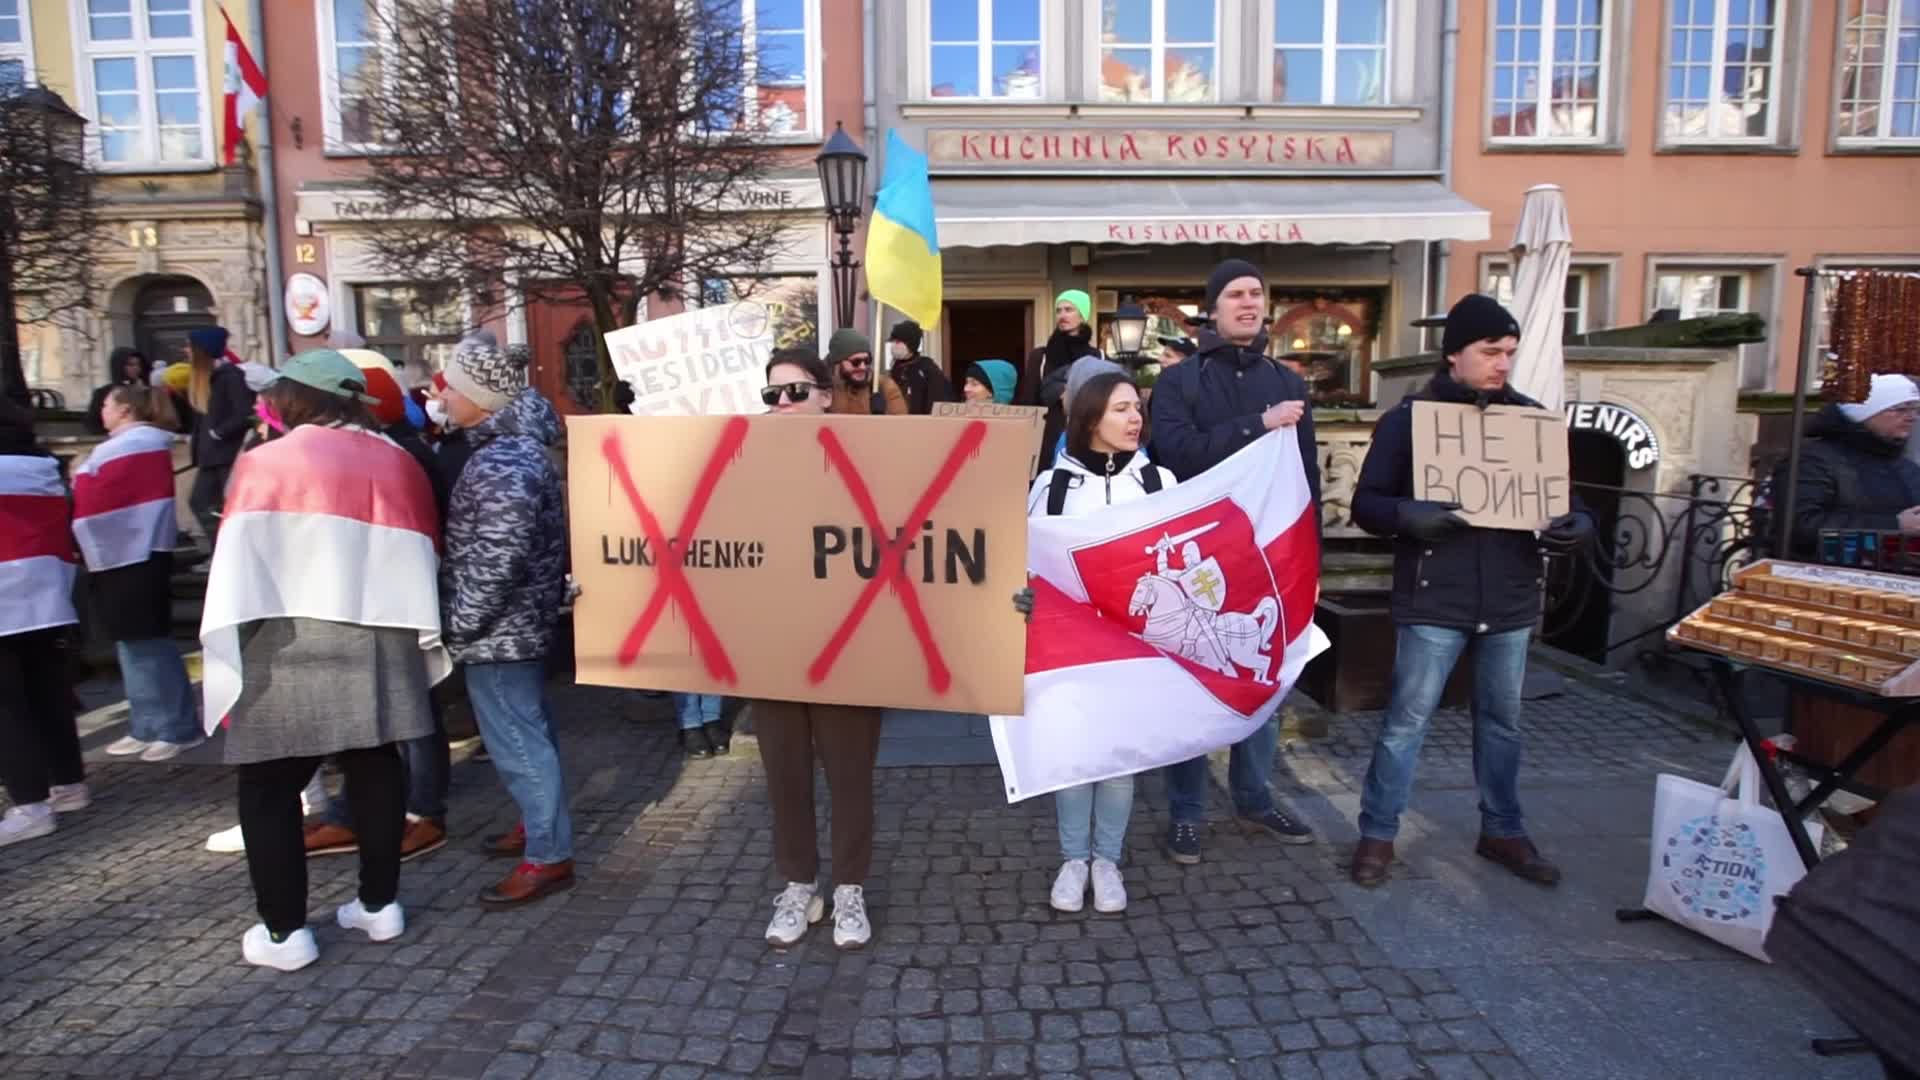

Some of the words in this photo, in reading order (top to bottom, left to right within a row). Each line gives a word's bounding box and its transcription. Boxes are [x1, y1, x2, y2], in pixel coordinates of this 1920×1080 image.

[961, 133, 1143, 161] KUCHNIA
[331, 201, 392, 216] TAPA
[739, 190, 792, 206] WINE
[130, 227, 158, 248] 13
[295, 244, 315, 263] 12
[1434, 410, 1561, 464] НЕТ
[1424, 463, 1567, 521] ВОЙНЕ
[601, 534, 765, 569] LUKHENKO
